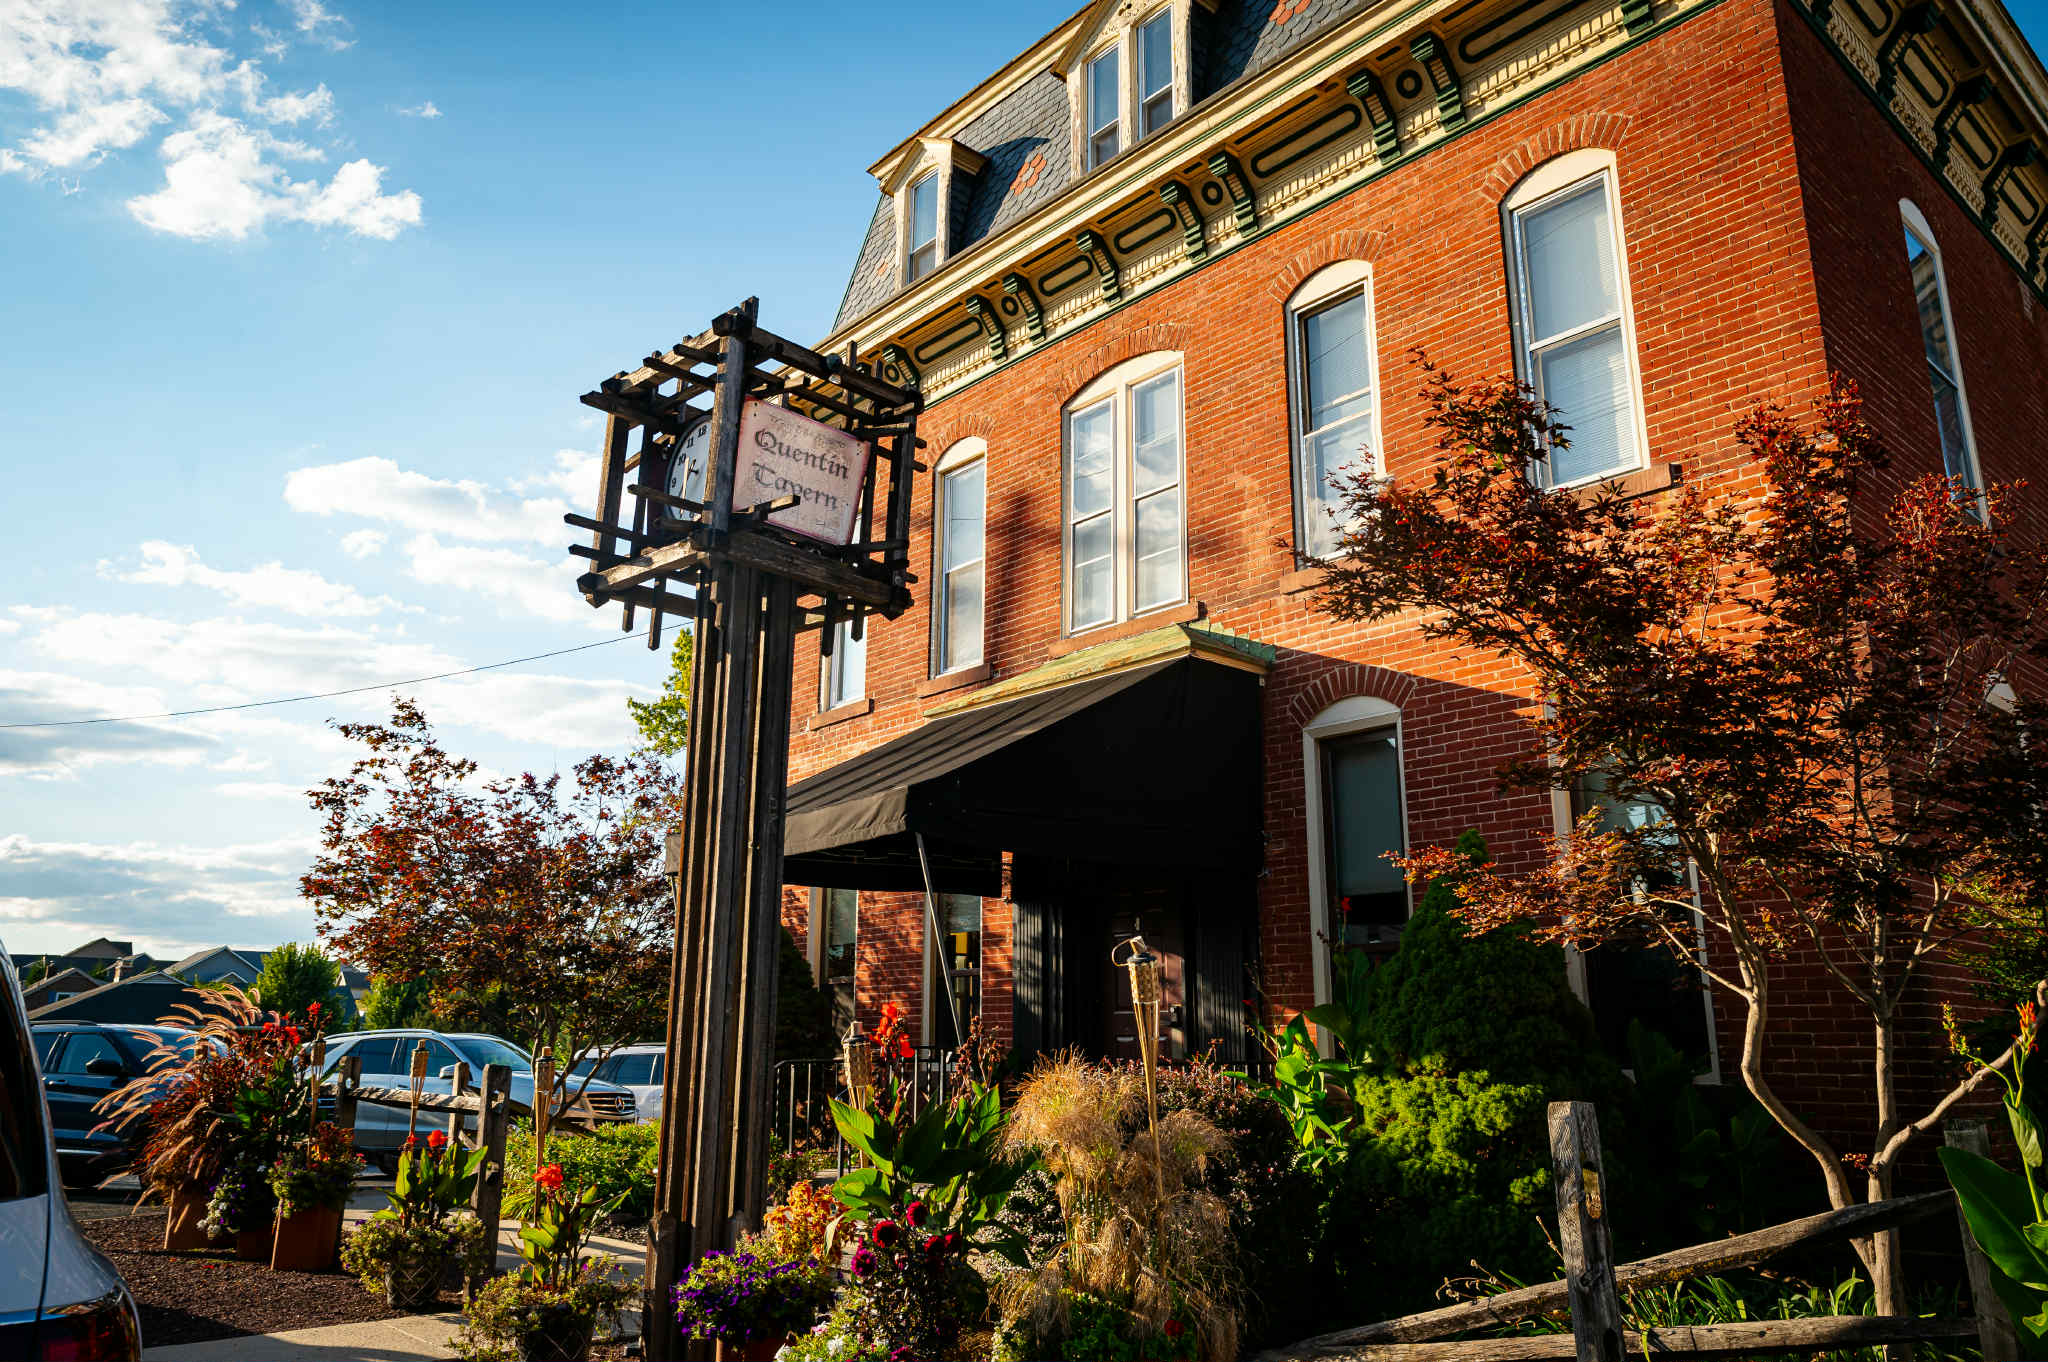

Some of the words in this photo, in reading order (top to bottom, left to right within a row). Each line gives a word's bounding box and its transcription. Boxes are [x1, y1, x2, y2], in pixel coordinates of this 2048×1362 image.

[687, 436, 694, 448] 11
[754, 428, 848, 479] Quentin
[752, 462, 838, 512] Tavern
